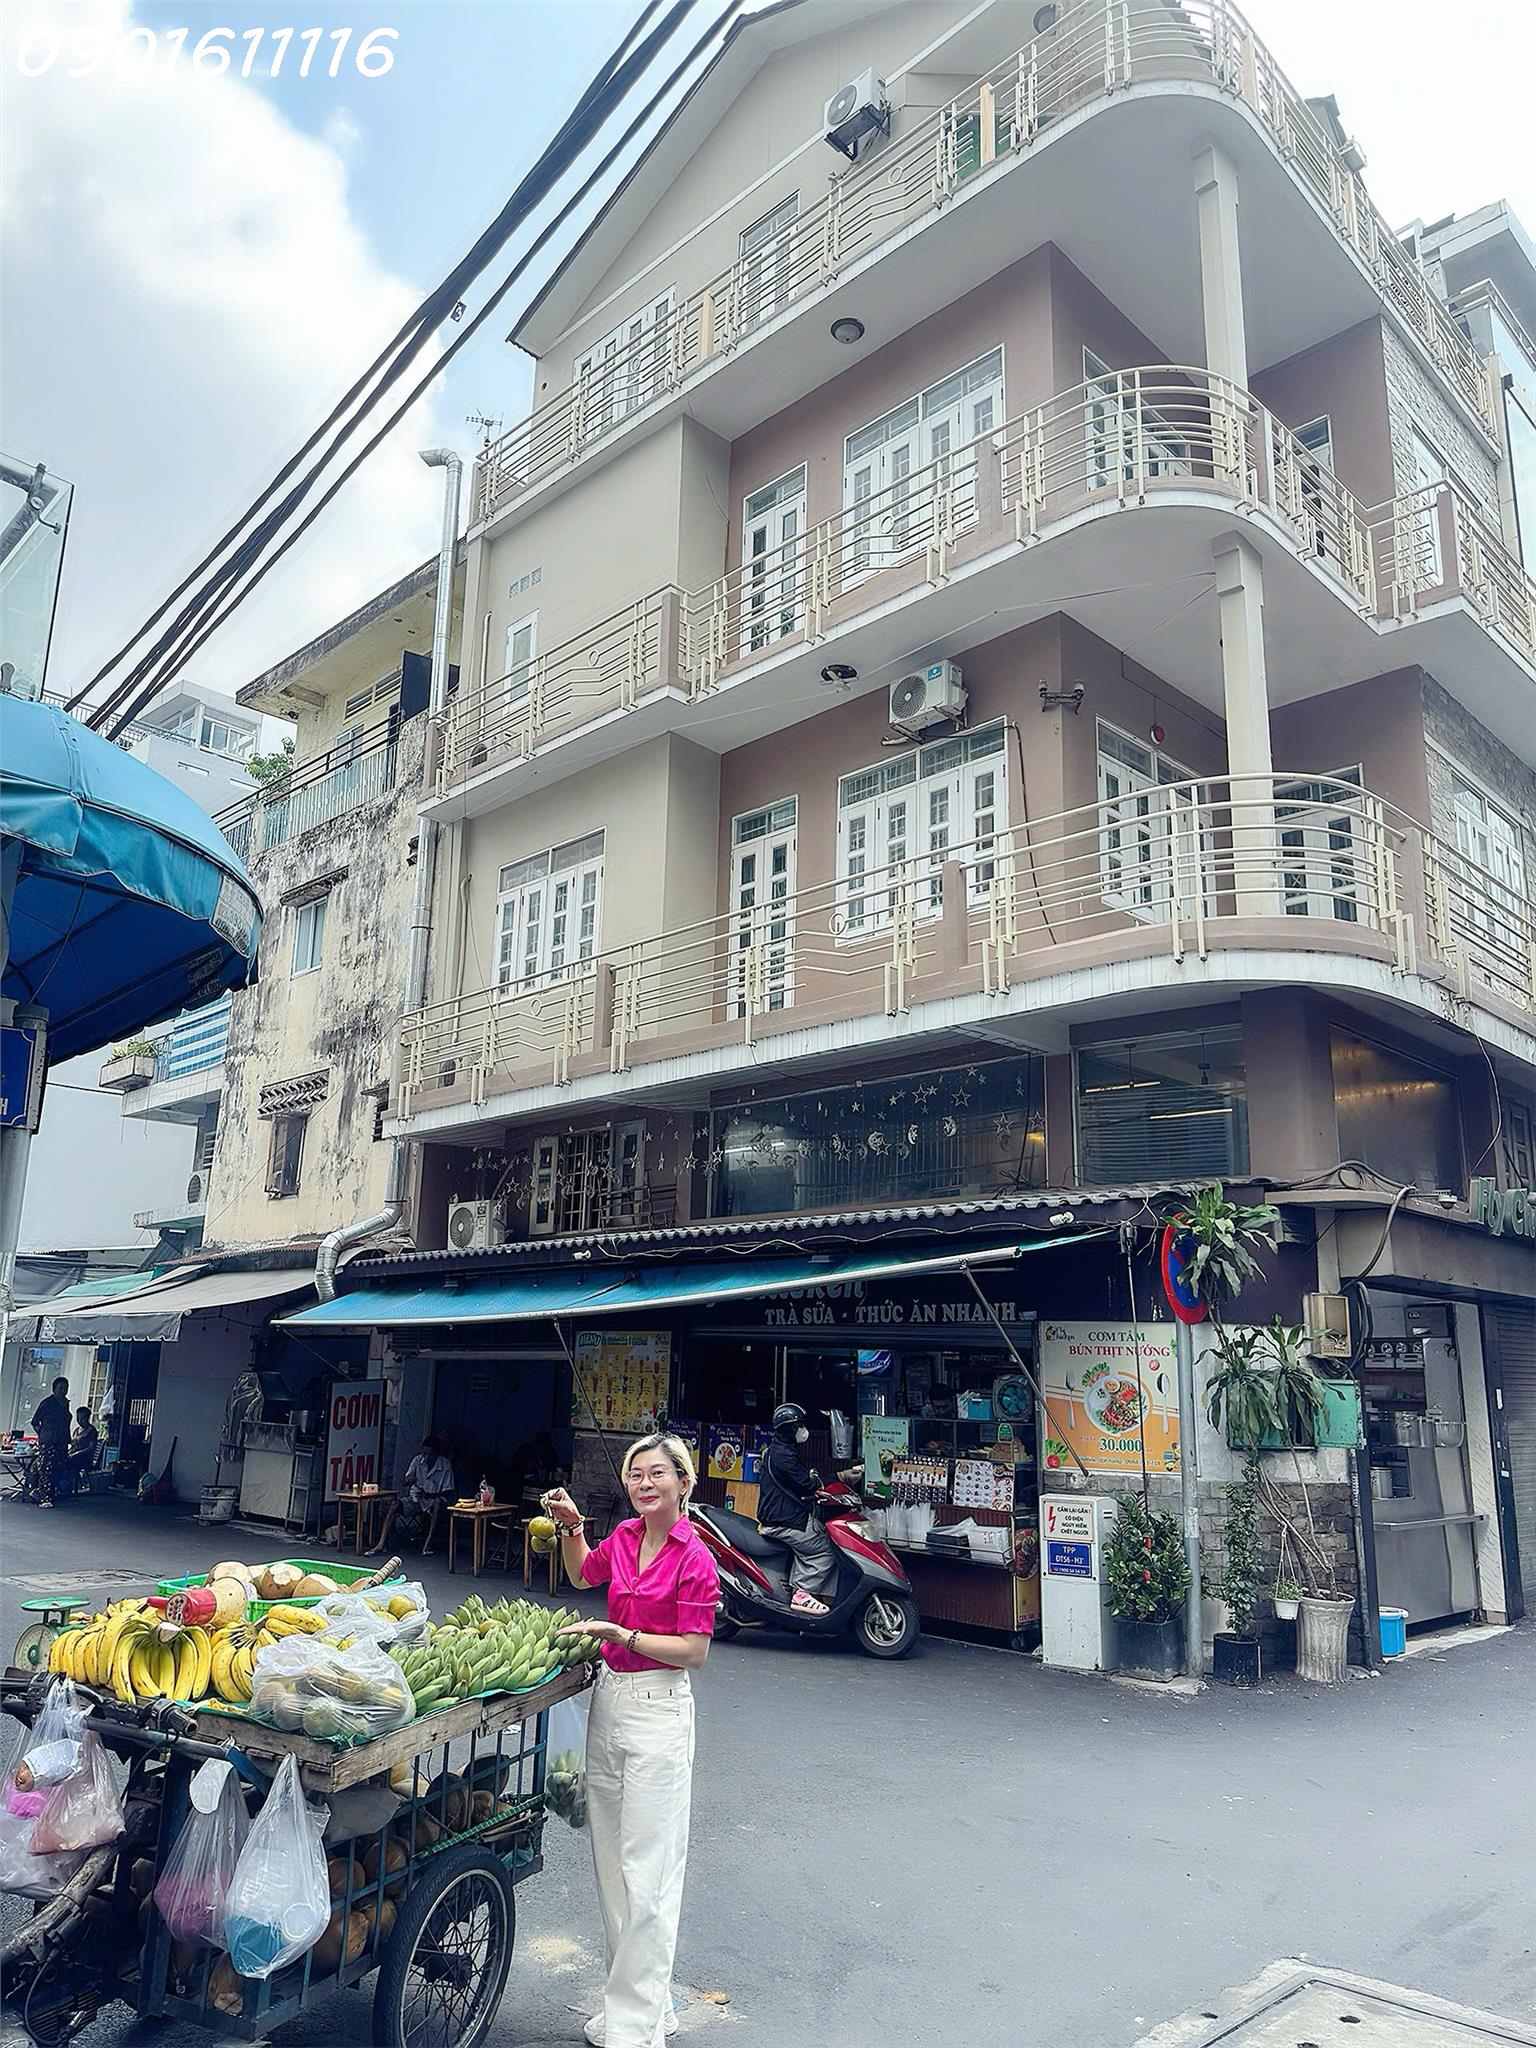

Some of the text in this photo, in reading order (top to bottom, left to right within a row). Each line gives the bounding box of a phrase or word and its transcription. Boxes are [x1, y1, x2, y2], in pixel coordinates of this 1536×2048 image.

[765, 1302, 799, 1326] TRÀ
[803, 1300, 835, 1325] SỮA
[856, 1299, 903, 1324] THỨC
[909, 1298, 936, 1323] ĂN
[941, 1302, 1016, 1323] NHANH
[1088, 1329, 1146, 1342] CƠM TẤM
[1069, 1343, 1170, 1358] BÚN THỊT NƯỚNG
[332, 1391, 381, 1430] CƠM
[1099, 1438, 1142, 1452] 30.000
[330, 1443, 375, 1492] TẤM
[1063, 1546, 1076, 1554] TPP
